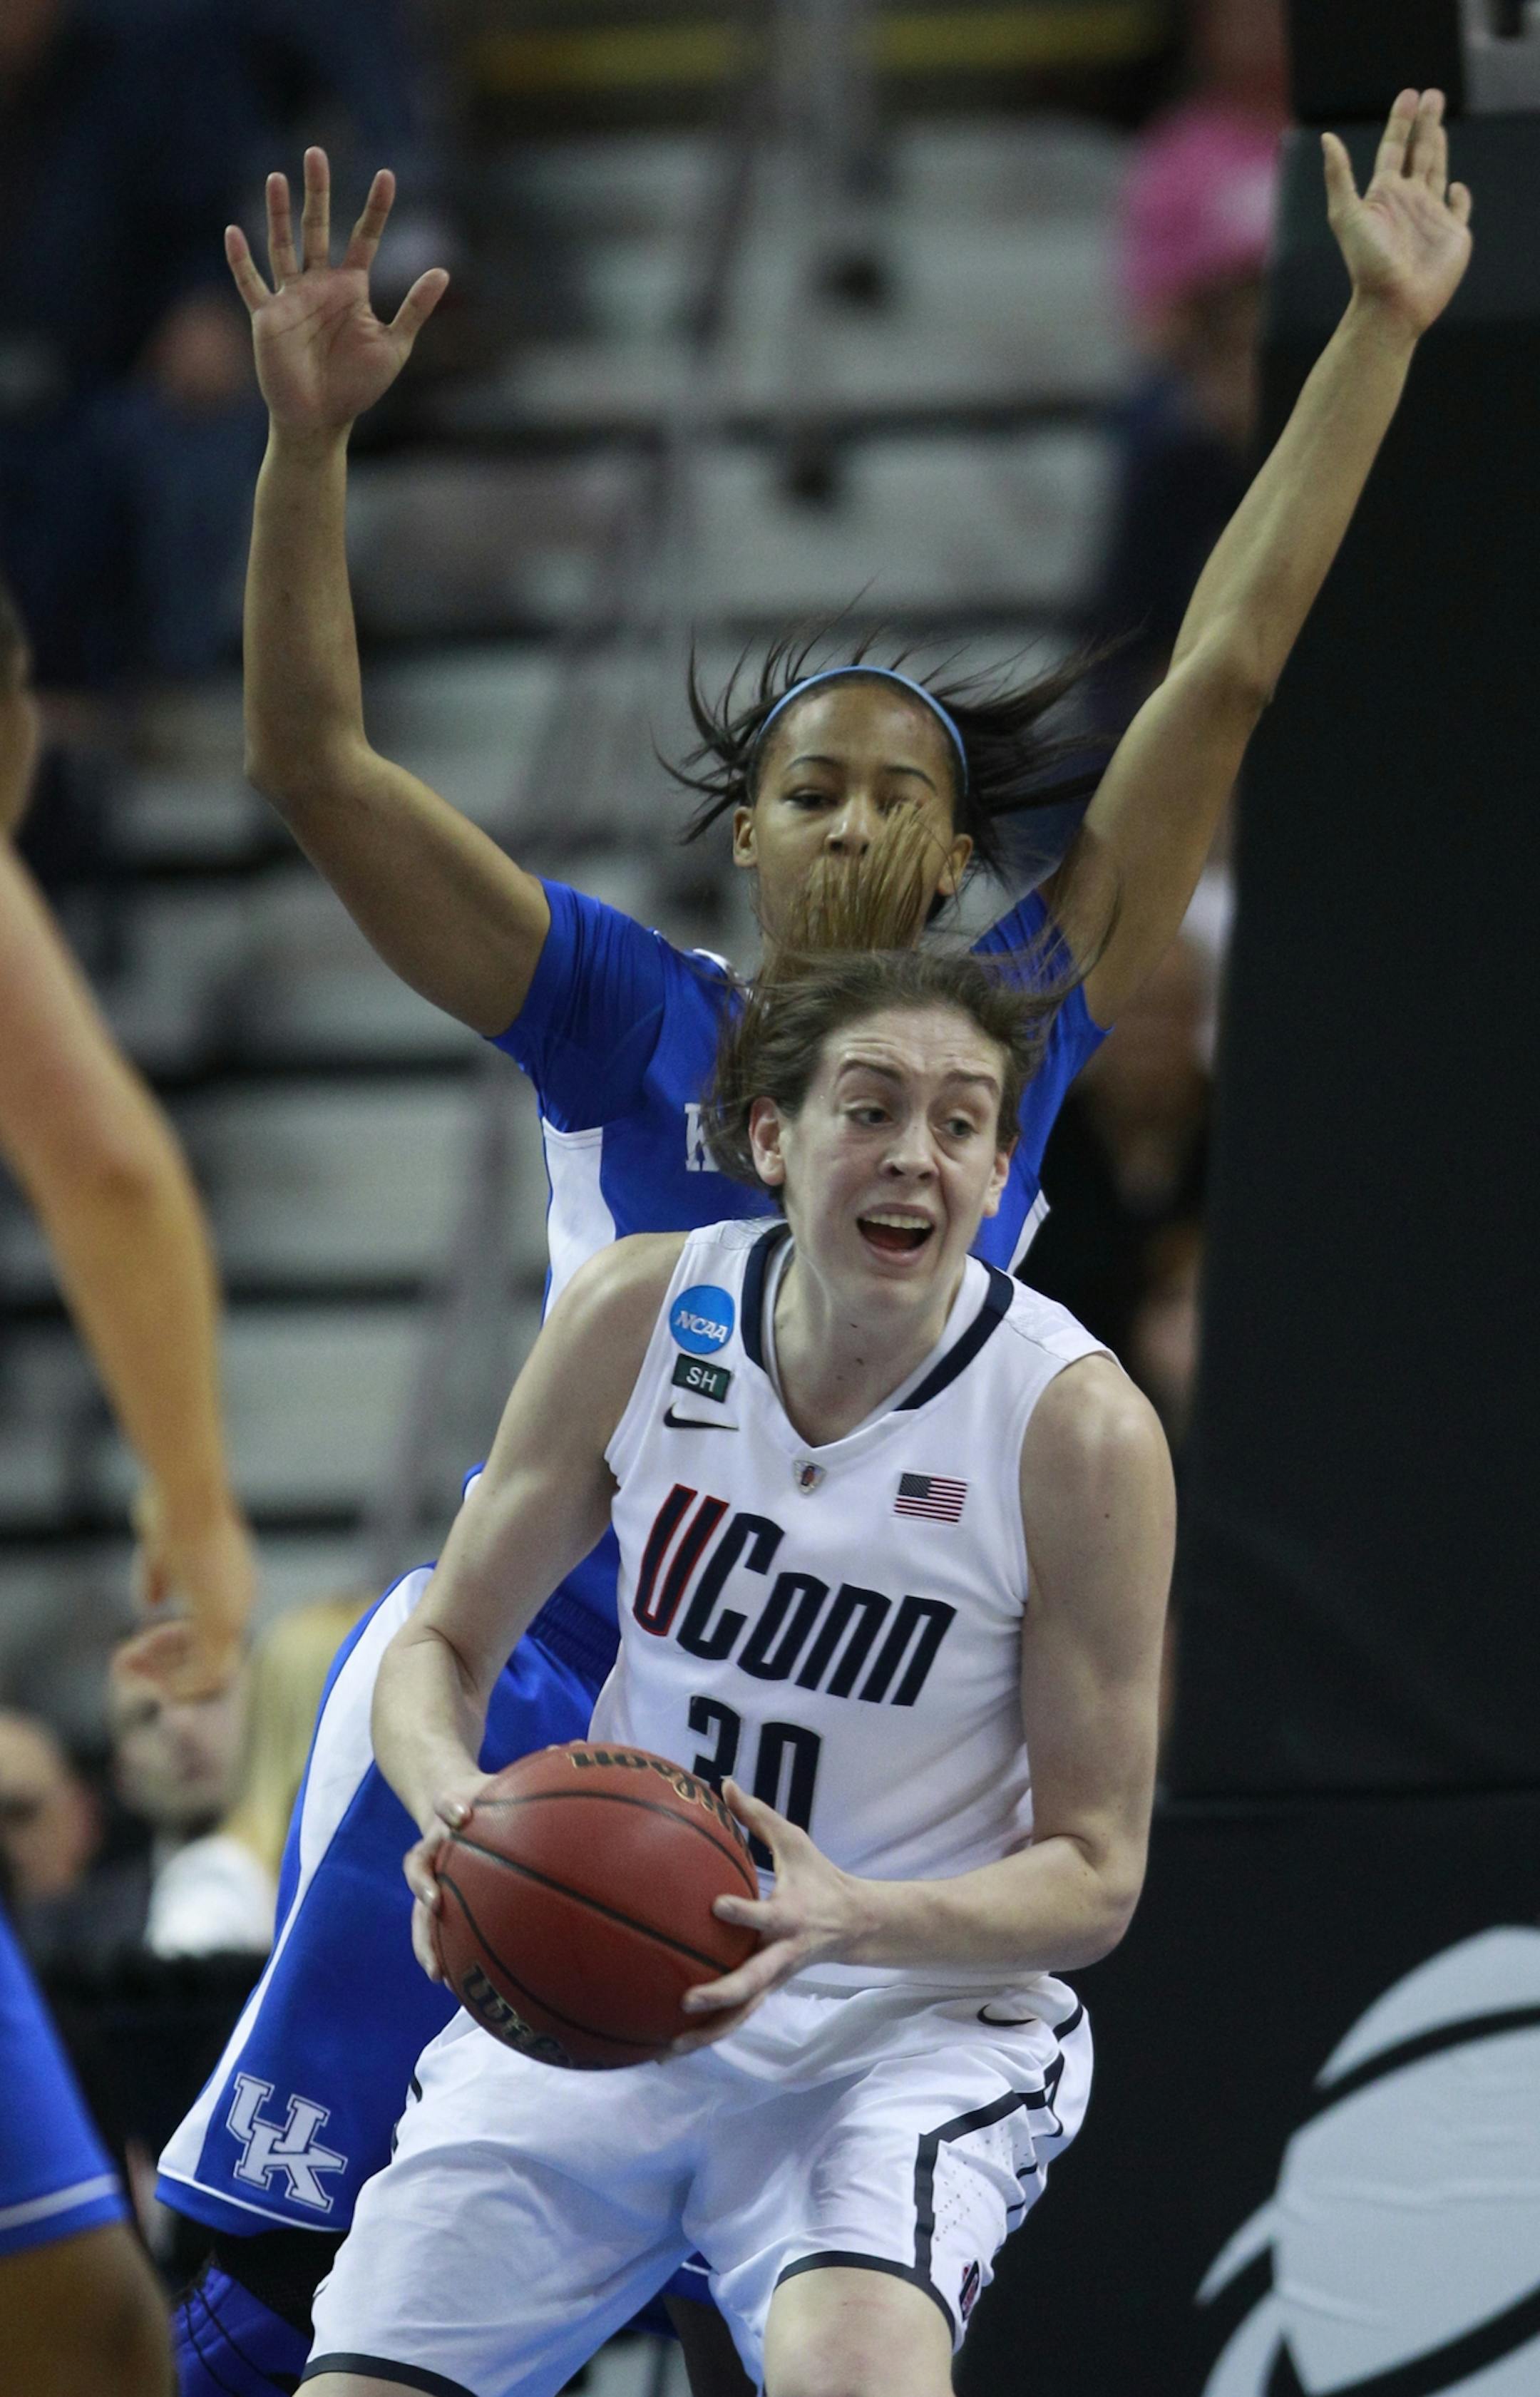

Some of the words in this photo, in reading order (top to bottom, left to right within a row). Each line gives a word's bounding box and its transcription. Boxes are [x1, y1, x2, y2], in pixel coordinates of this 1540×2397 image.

[674, 1310, 729, 1343] NCAA
[686, 1366, 717, 1392] SH
[226, 2071, 348, 2213] UK
